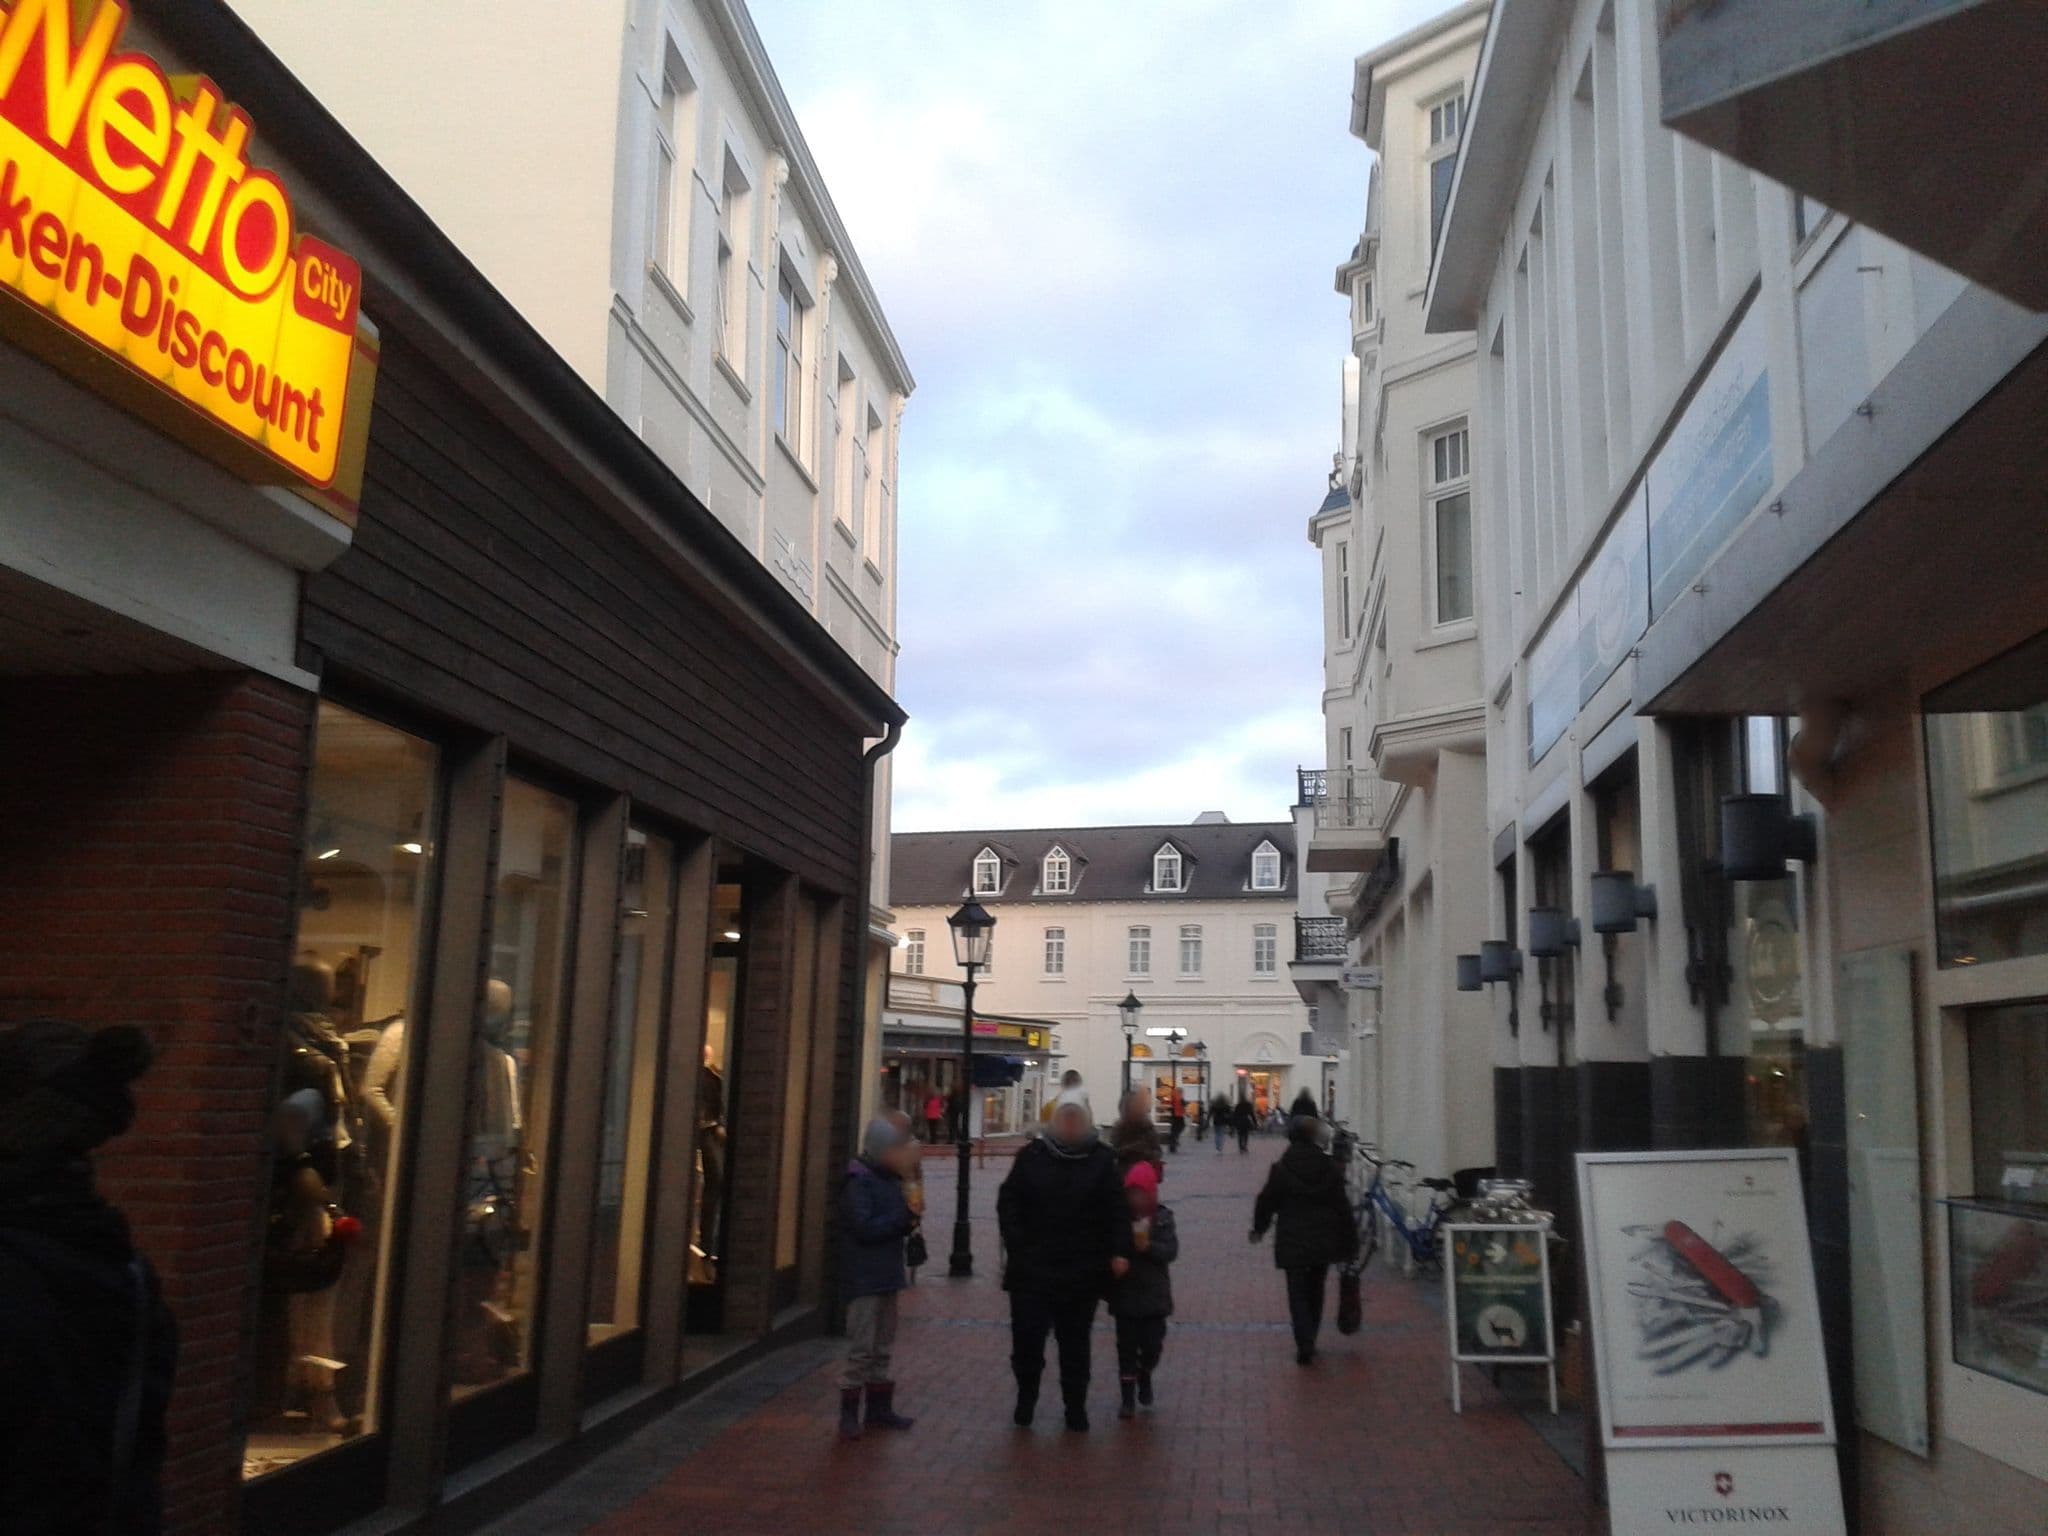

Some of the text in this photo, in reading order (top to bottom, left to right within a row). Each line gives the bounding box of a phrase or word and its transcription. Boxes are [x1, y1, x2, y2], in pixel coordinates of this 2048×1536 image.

[0, 0, 290, 295] Netto
[303, 256, 352, 321] City
[1665, 1507, 1789, 1523] VICTORINOX
